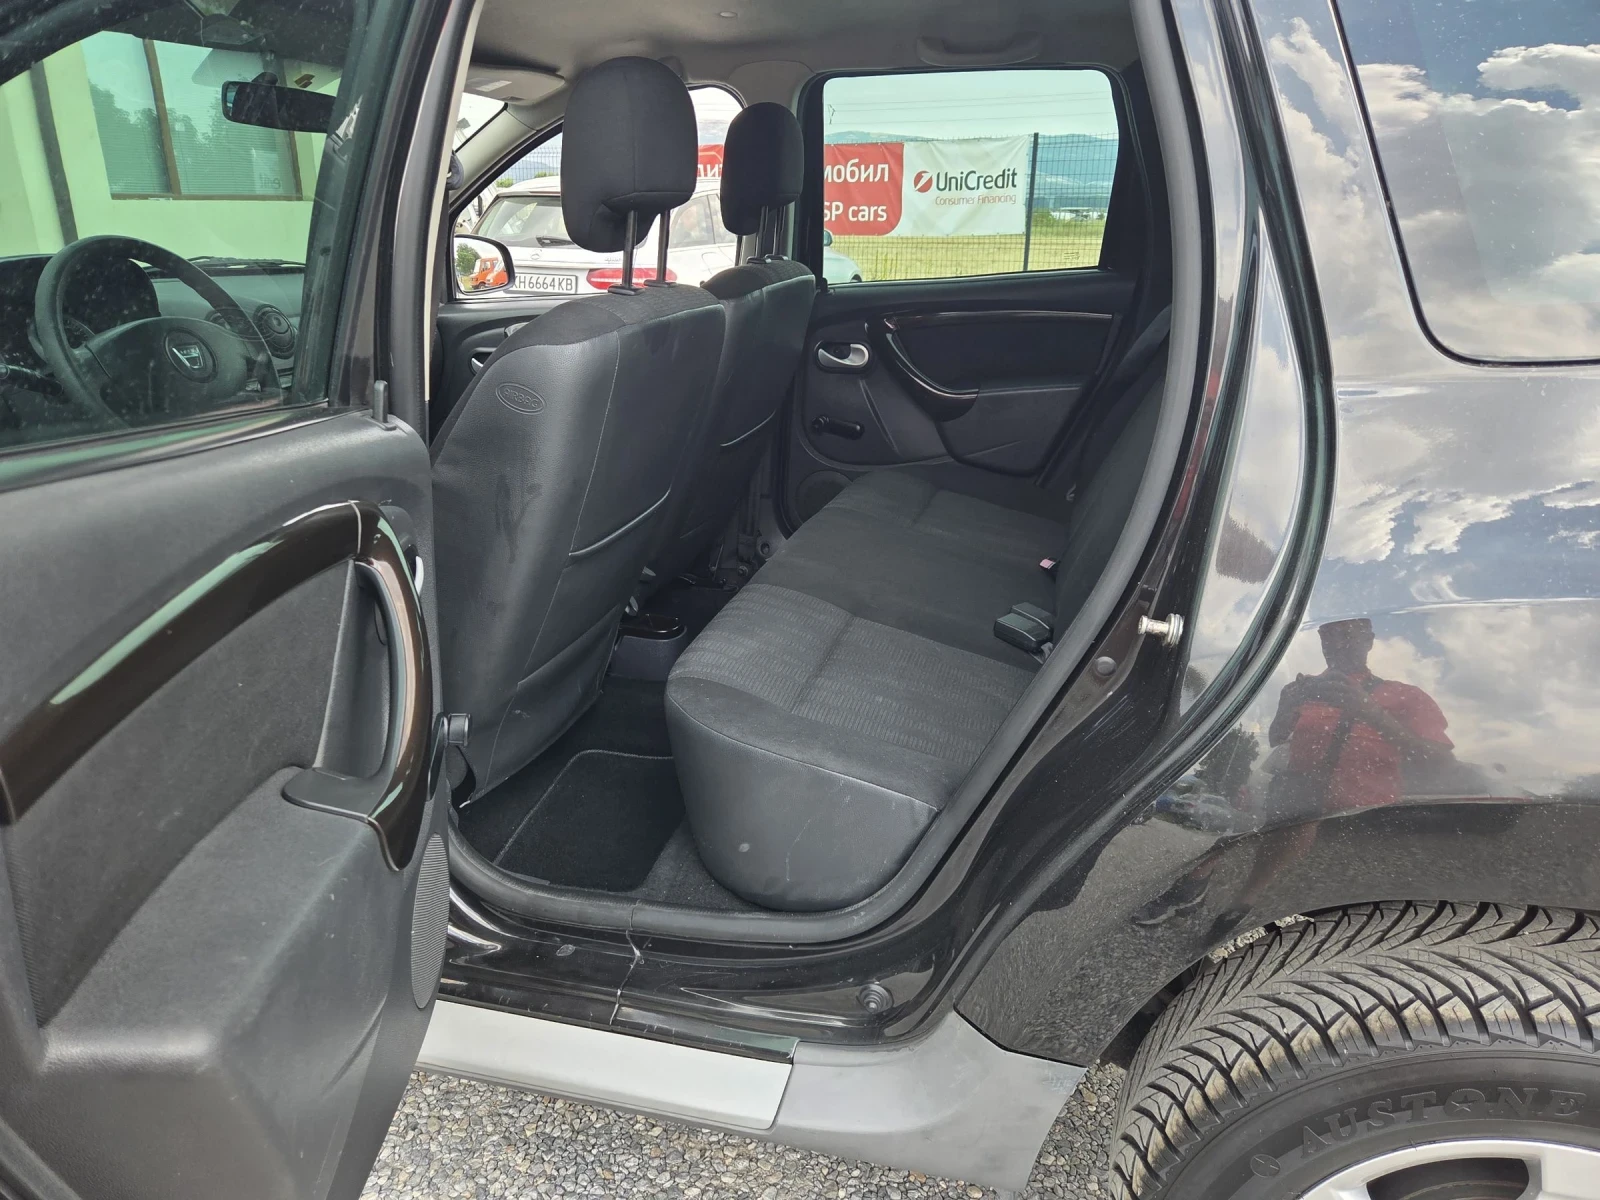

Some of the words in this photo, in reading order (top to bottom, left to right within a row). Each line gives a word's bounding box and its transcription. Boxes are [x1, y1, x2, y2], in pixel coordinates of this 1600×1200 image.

[936, 167, 1018, 192] UniCredit
[935, 195, 976, 206] Consumer
[977, 193, 1017, 206] Financing
[848, 205, 888, 222] cars
[1301, 1087, 1587, 1159] AUSTONE
